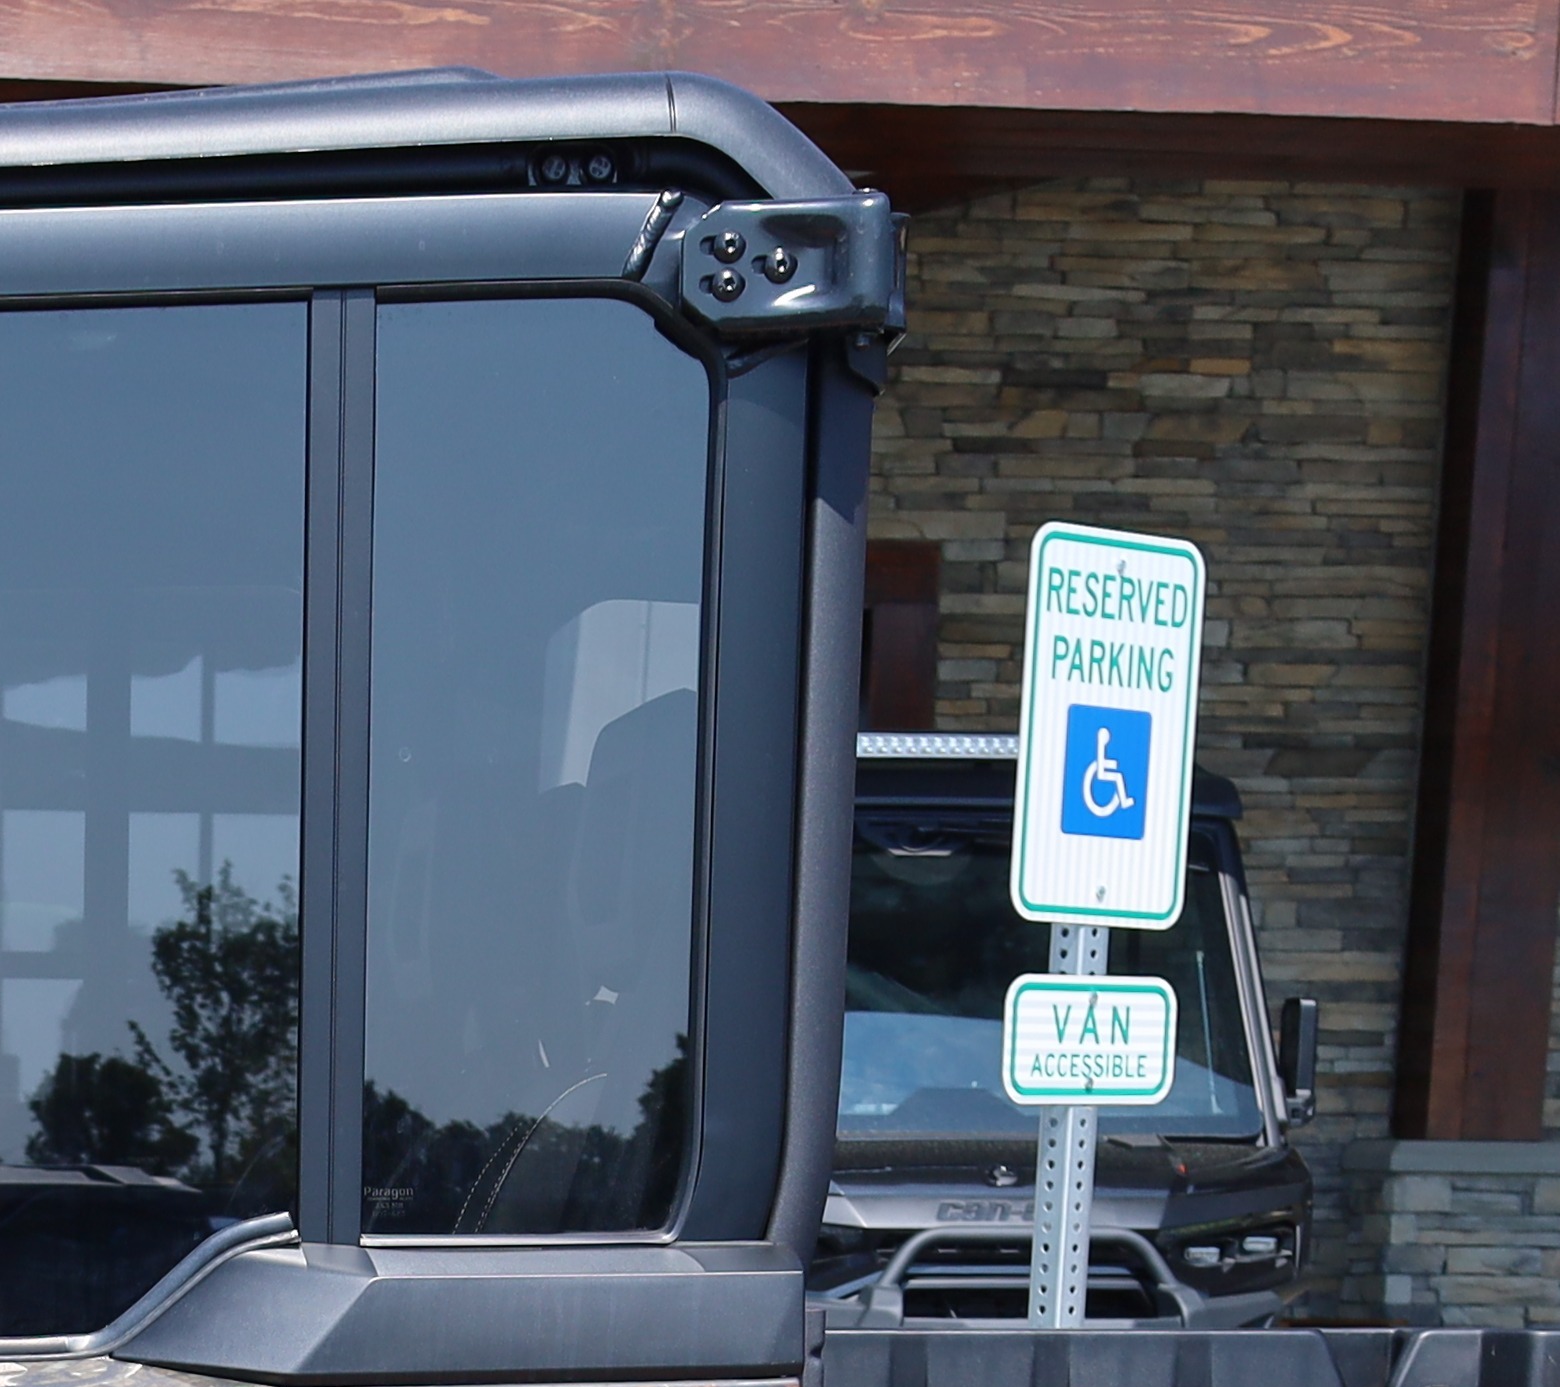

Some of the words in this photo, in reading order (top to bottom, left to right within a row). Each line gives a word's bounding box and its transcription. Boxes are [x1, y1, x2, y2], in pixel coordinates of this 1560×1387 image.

[1046, 567, 1187, 628] RESERVED
[1051, 635, 1173, 693] PARKING
[1052, 1004, 1130, 1045] VAN
[1031, 1053, 1148, 1079] ACCESSIBLE
[364, 1187, 413, 1200] Paragon
[936, 1200, 1034, 1221] can-
